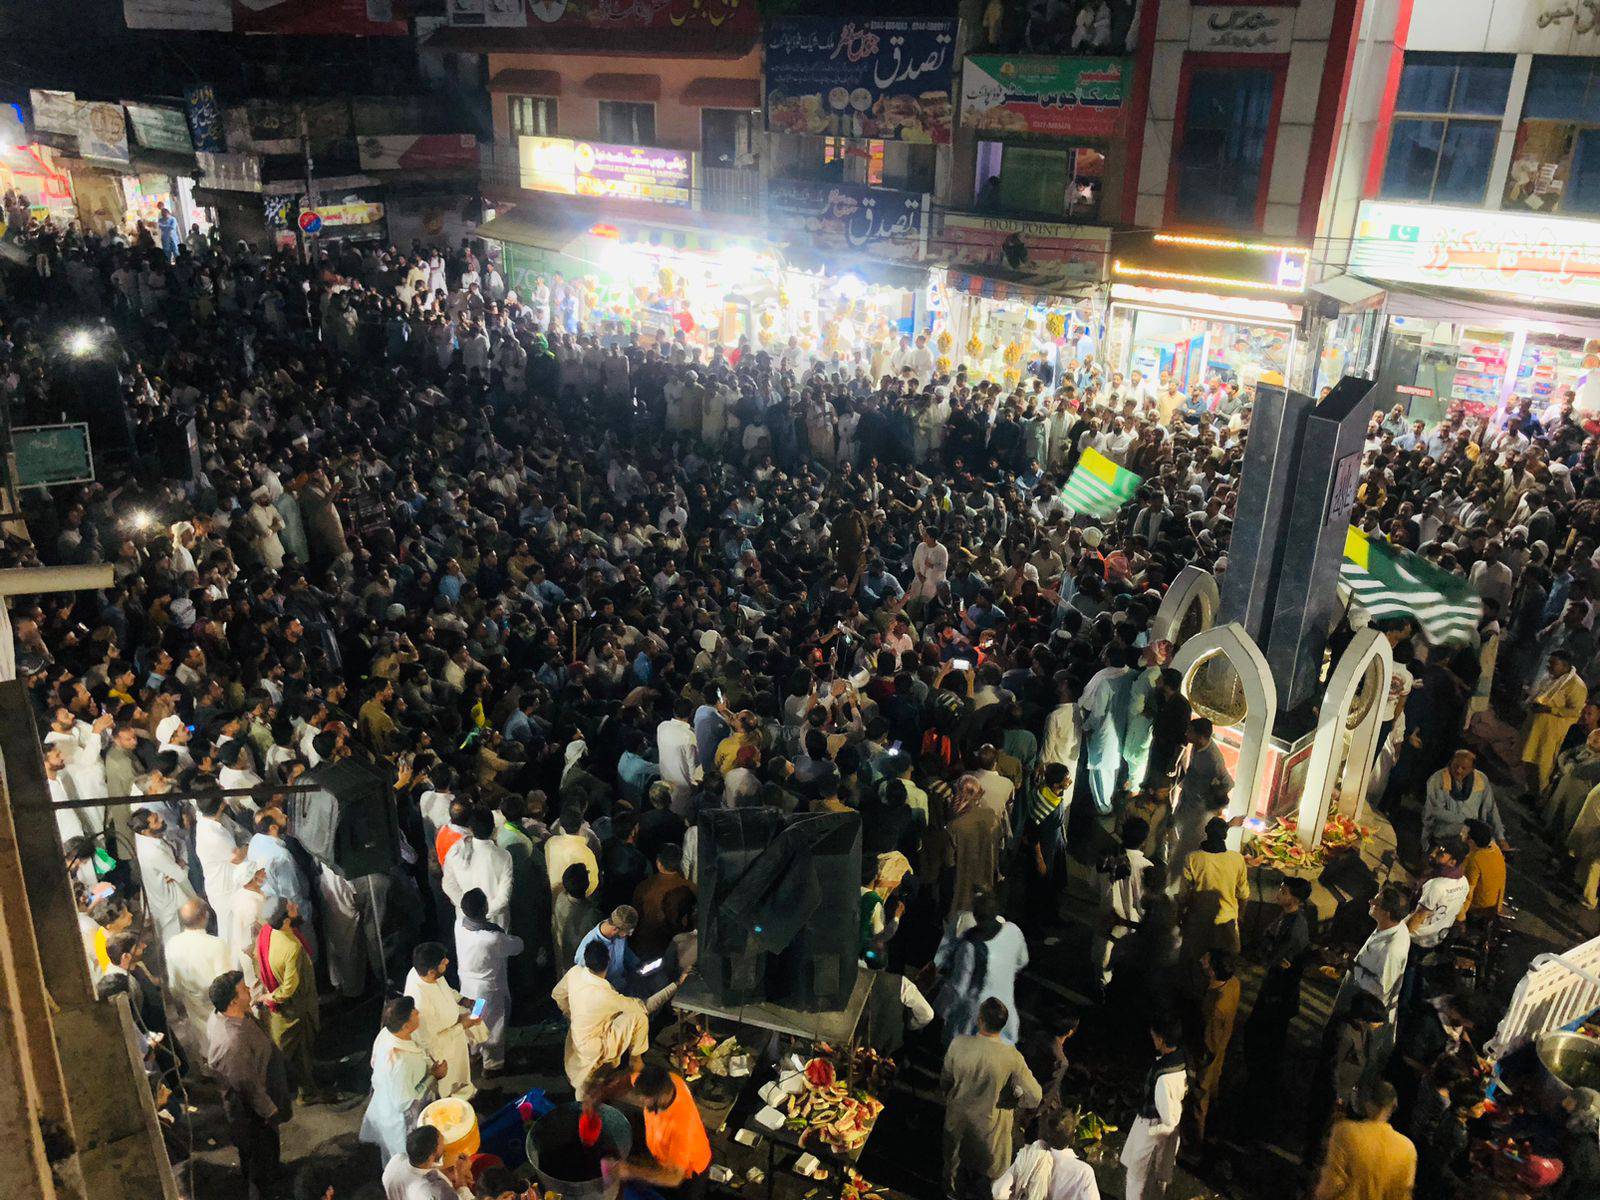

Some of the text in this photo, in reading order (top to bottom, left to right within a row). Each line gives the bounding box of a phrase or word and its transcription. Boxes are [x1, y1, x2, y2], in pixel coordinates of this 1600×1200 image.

[873, 35, 953, 89] تصدق
[848, 197, 920, 246] تصدق
[983, 218, 1017, 232] FOOD
[1022, 222, 1060, 236] POINT
